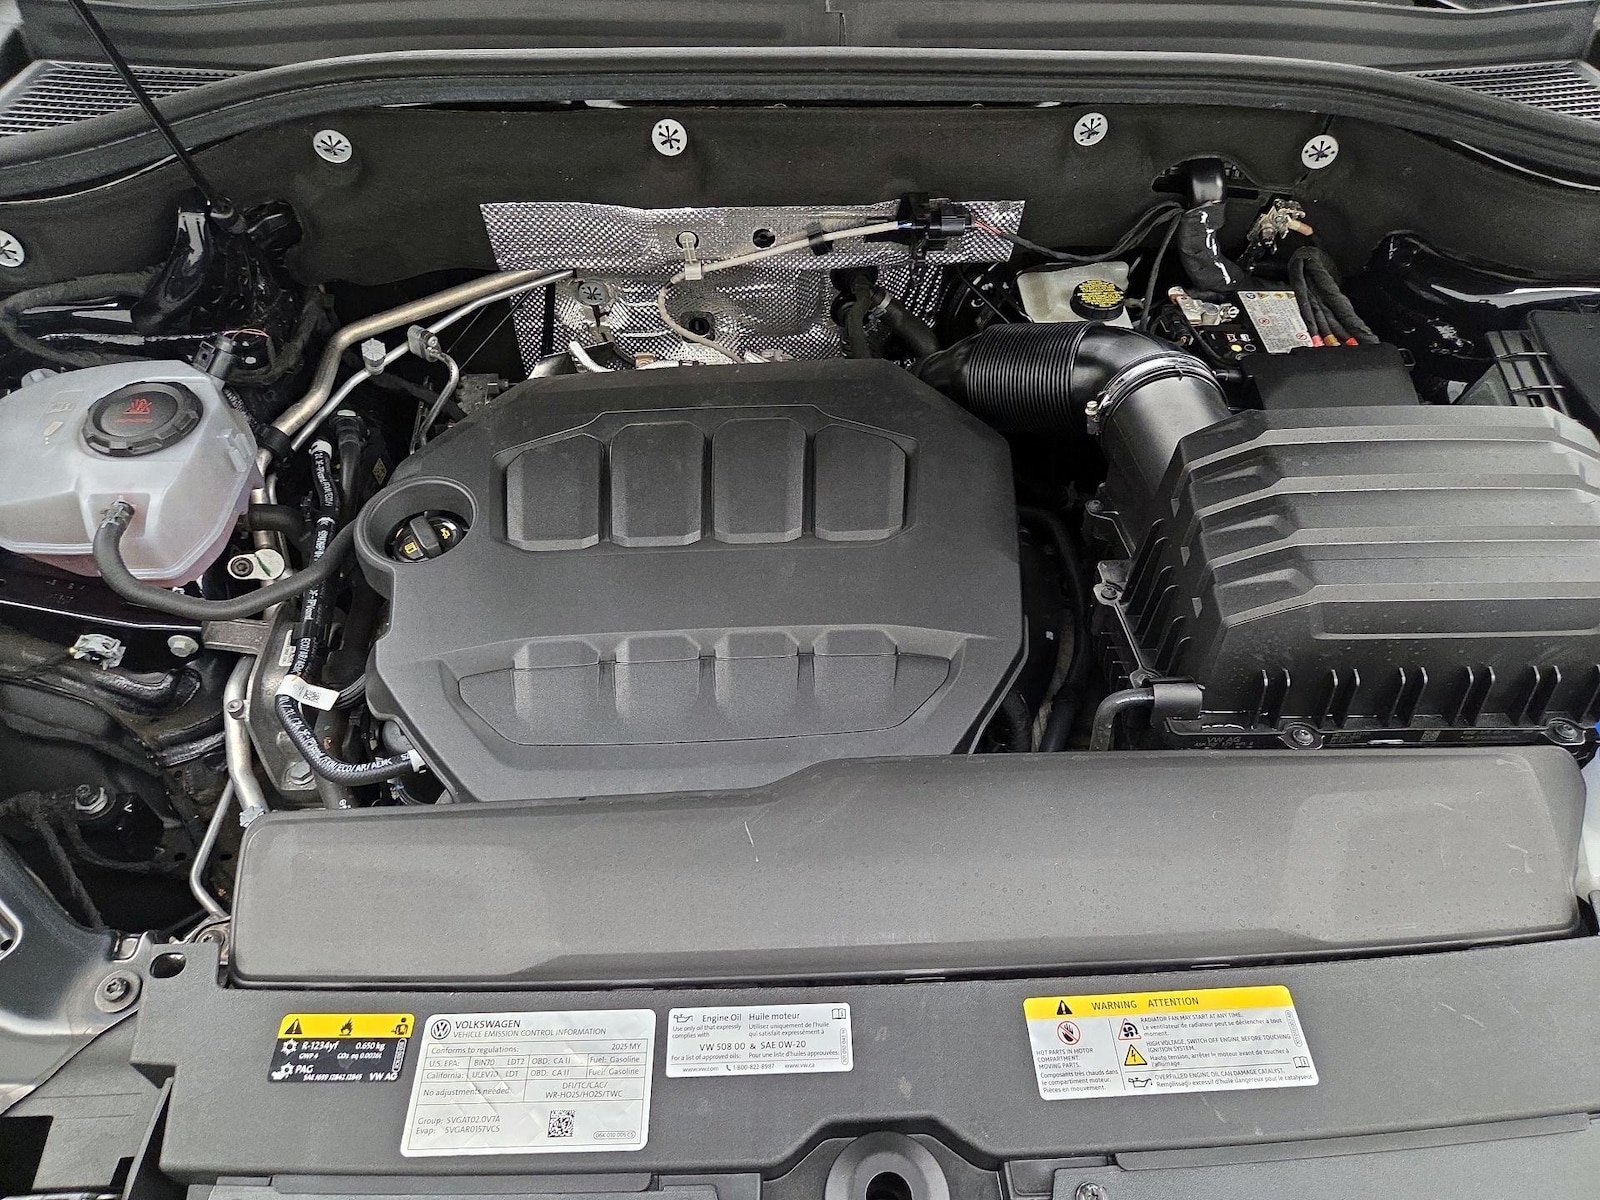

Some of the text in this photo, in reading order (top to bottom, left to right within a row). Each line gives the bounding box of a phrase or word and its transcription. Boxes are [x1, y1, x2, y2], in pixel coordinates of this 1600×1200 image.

[1092, 997, 1199, 1010] WARNING ATTENTION
[702, 1014, 729, 1024] Engine
[749, 1012, 800, 1020] Huile moteur
[455, 1020, 521, 1030] VOLKSWAGEN
[770, 1022, 804, 1030] uniquement
[556, 1028, 606, 1036] INFORMATION
[302, 1040, 386, 1052] R-1234yf 0.650 kg
[612, 1043, 628, 1051] 2025
[700, 1042, 714, 1051] VW
[716, 1042, 732, 1050] 508
[734, 1042, 746, 1050] 00
[760, 1041, 776, 1050] SAE
[778, 1040, 807, 1048] 0W-20
[431, 1046, 466, 1055] Conforms
[476, 1046, 520, 1056] regulations:
[473, 1058, 496, 1066] BIN70
[532, 1057, 550, 1065] OBD:
[609, 1055, 640, 1063] Gasoline
[702, 1052, 729, 1061] approved
[294, 1064, 314, 1074] PAG
[426, 1071, 465, 1080] California:
[530, 1069, 550, 1077] OBD:
[608, 1067, 640, 1075] Gasoline
[370, 1072, 398, 1081] VW AG
[423, 1088, 435, 1096] No
[436, 1087, 482, 1098] adjustments
[418, 1116, 444, 1126] Group:
[416, 1127, 436, 1136] Evap:
